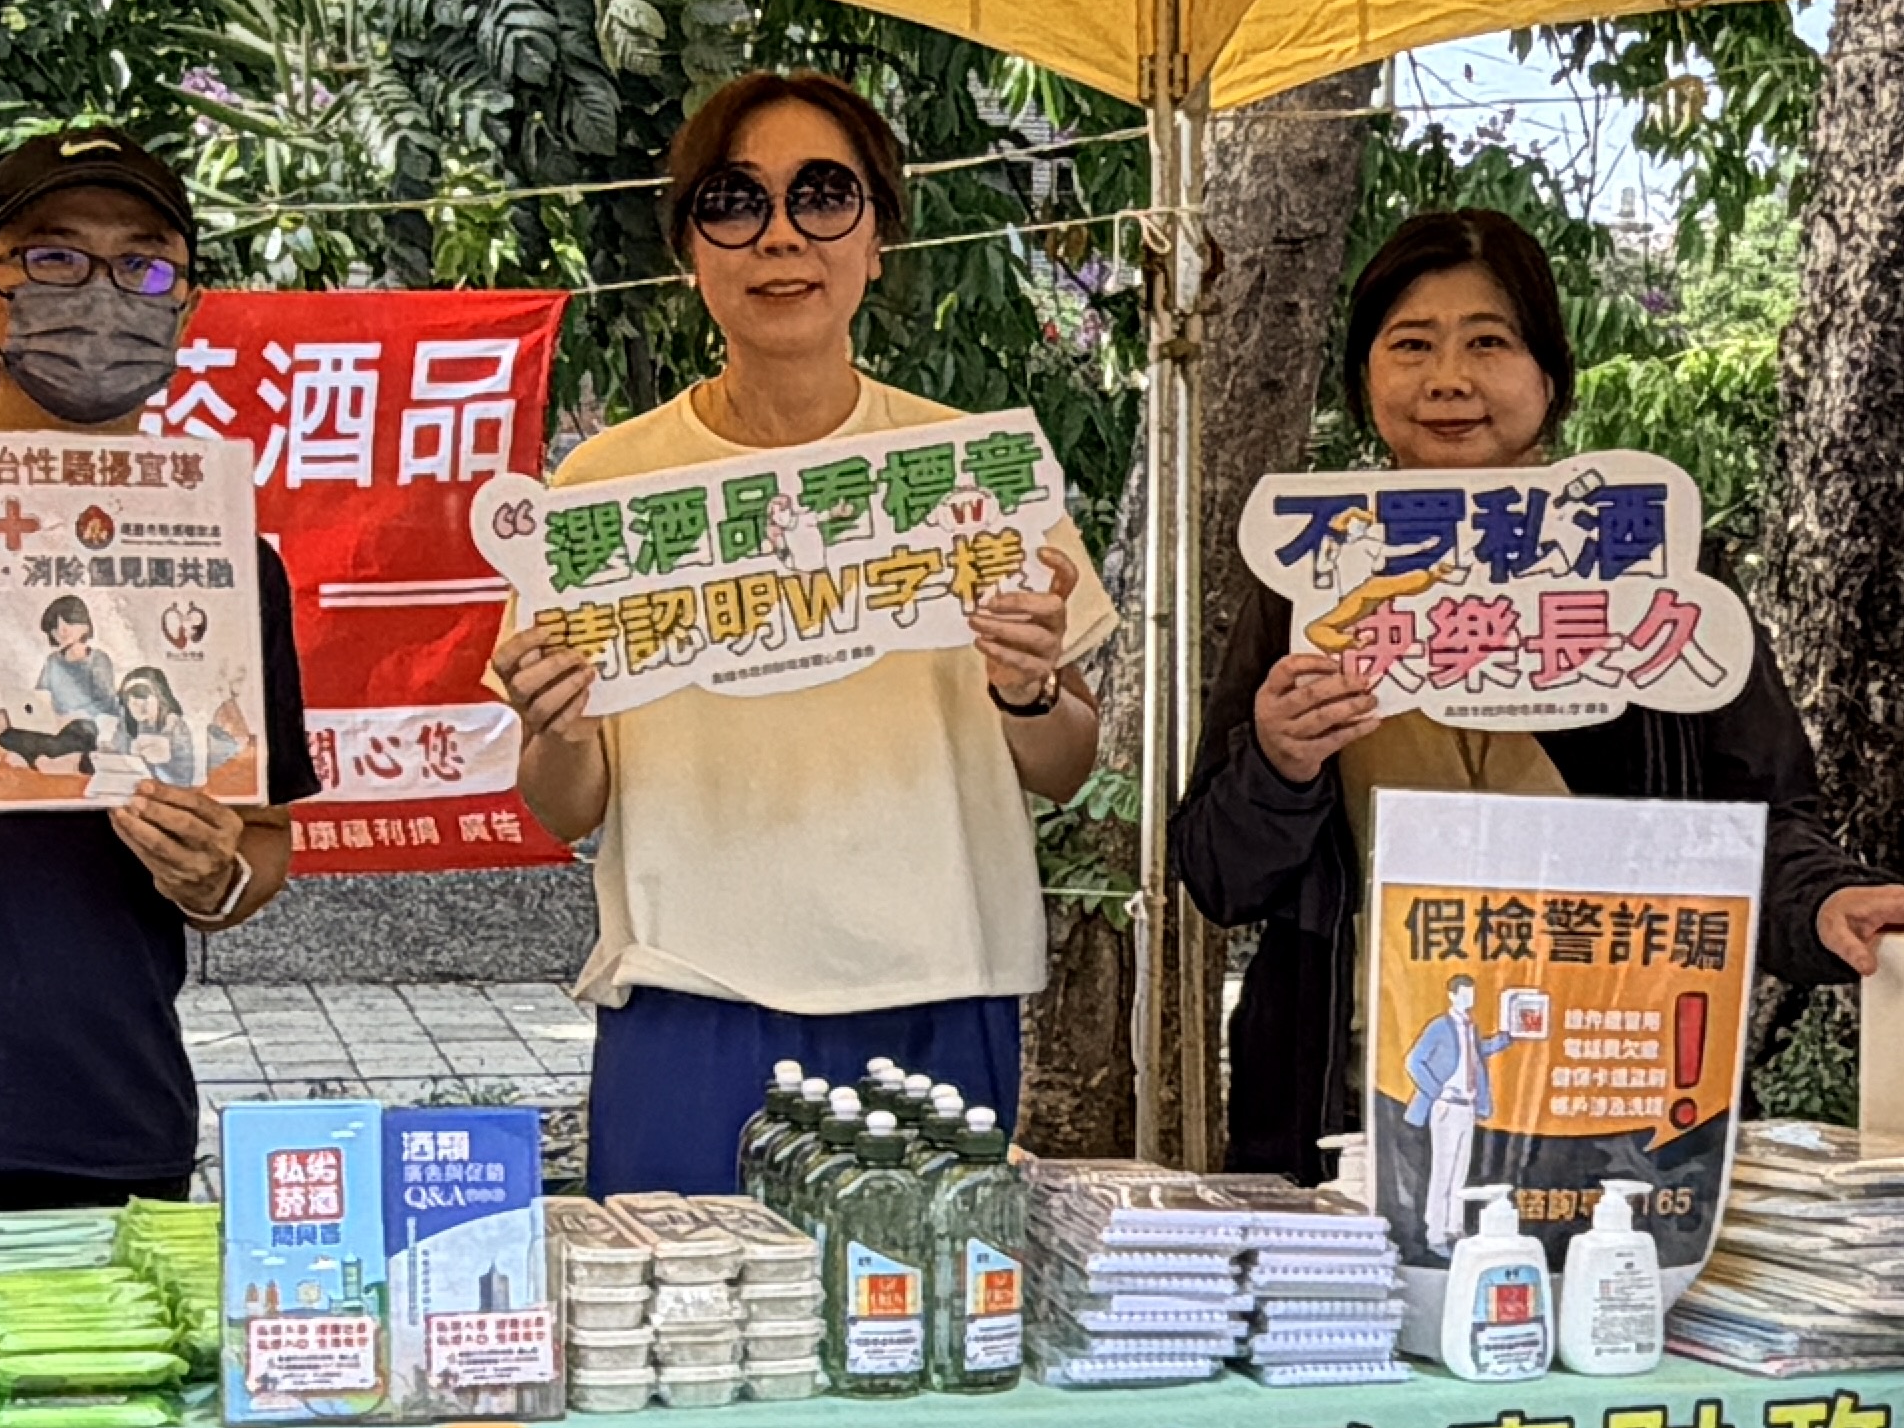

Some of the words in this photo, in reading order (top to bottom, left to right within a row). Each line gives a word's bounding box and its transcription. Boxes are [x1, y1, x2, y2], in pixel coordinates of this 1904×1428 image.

[458, 810, 523, 844] 廣告
[1404, 895, 1730, 972] 假檢警詐騙
